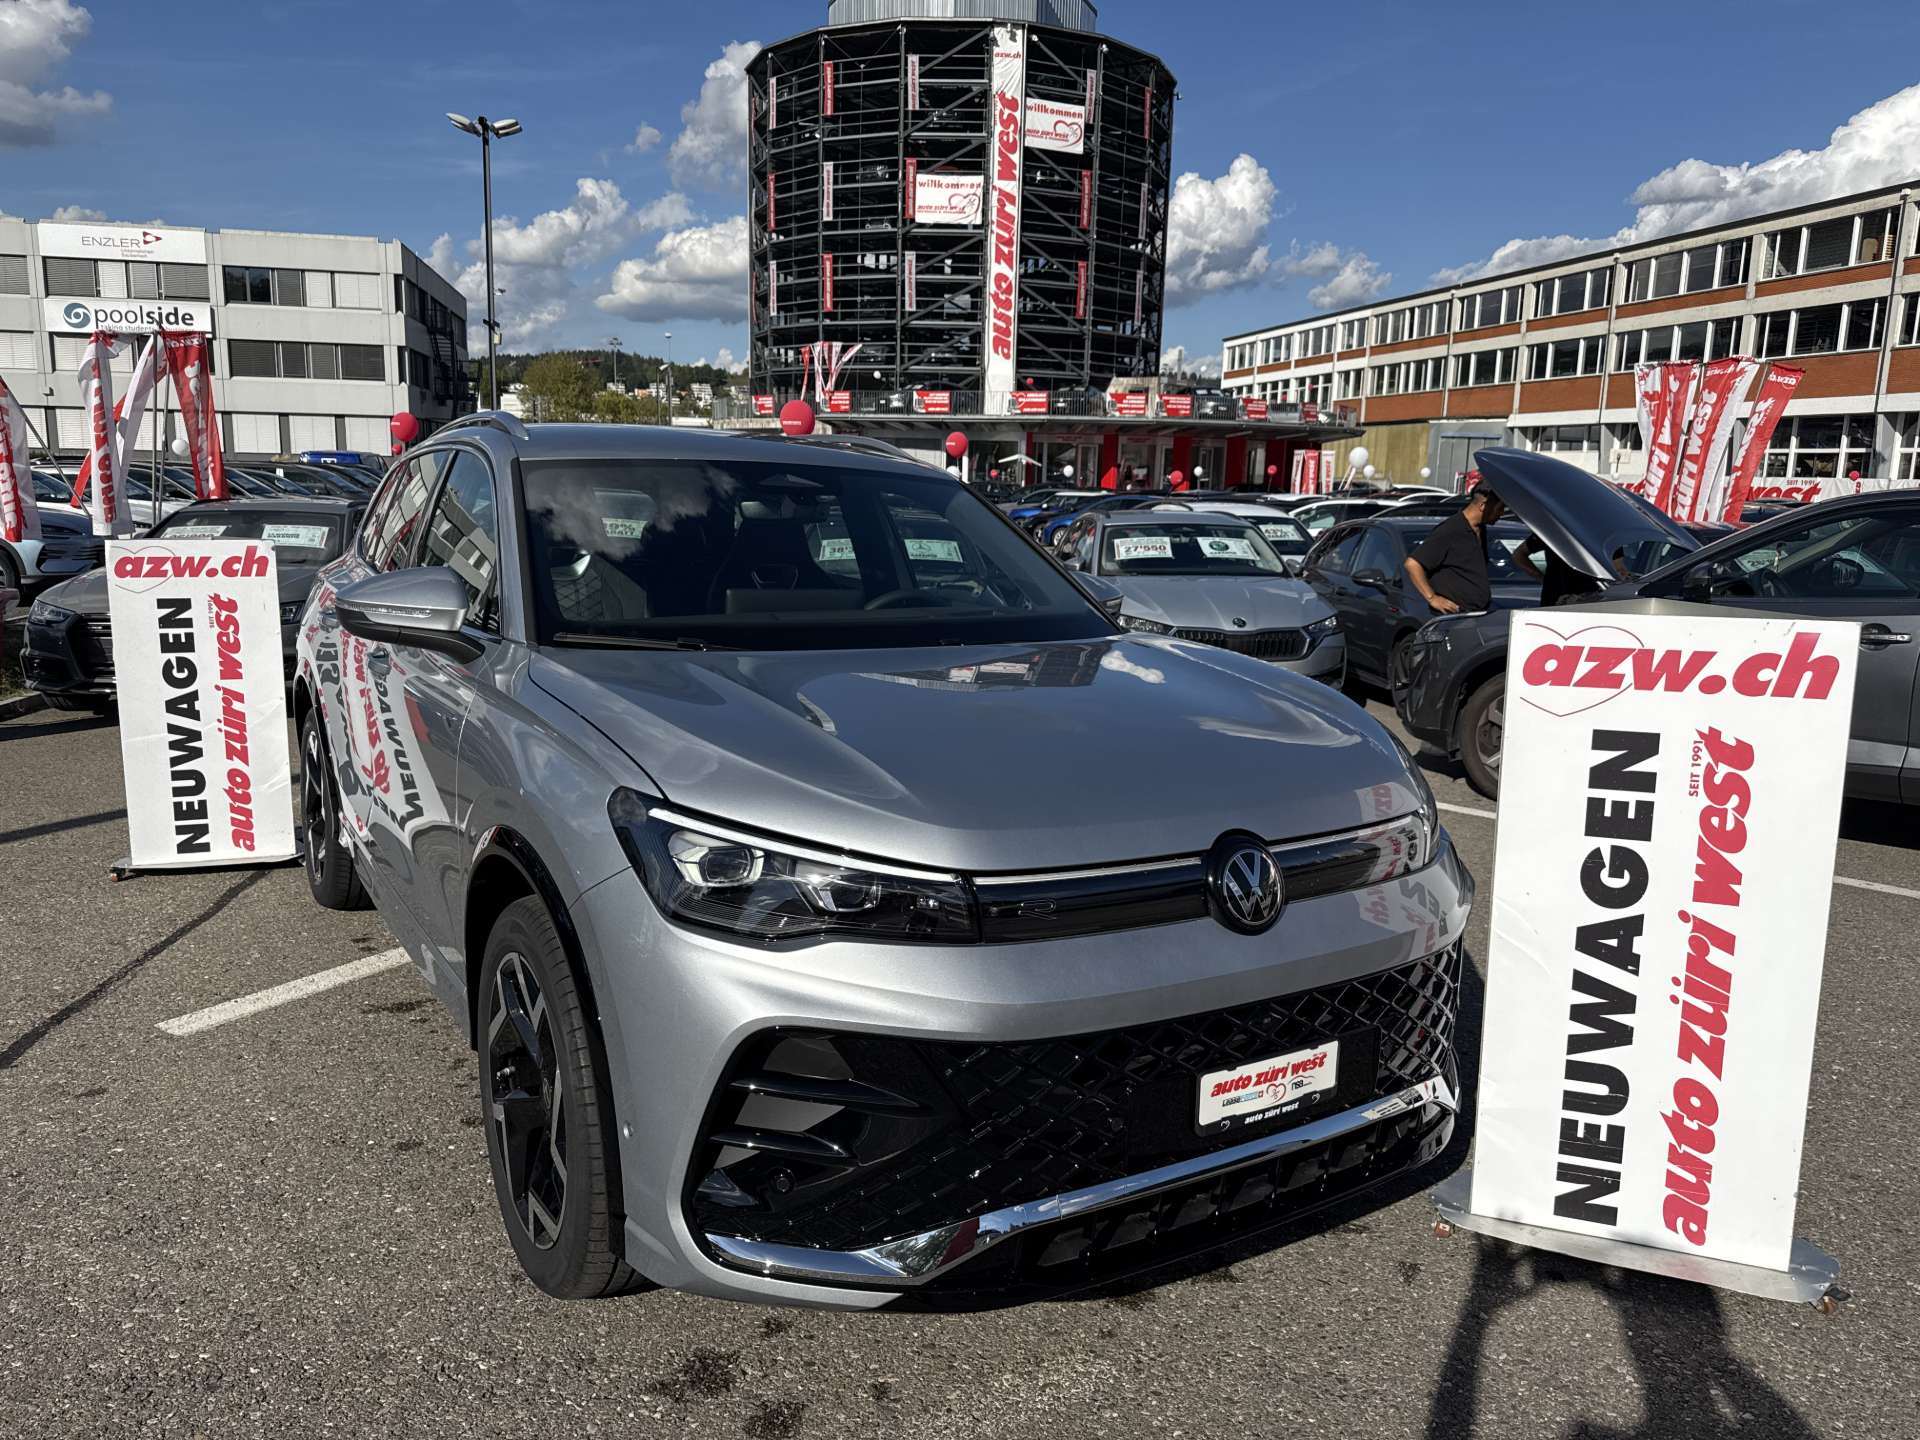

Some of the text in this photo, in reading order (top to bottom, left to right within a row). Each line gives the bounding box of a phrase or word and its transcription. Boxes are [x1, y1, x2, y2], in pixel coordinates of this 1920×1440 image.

[1025, 103, 1083, 119] willkommen
[81, 236, 141, 248] ENZLER
[990, 91, 1019, 361] auto züri west
[95, 305, 194, 329] poolside
[1688, 389, 1717, 456] west
[114, 546, 269, 578] azw.ch
[1522, 632, 1840, 700] azw.ch
[156, 597, 211, 855] NEUWAGEN
[208, 592, 255, 852] auto züri west
[1688, 738, 1704, 798] SEIT 1991
[1553, 728, 1661, 1227] NEUWAGEN
[1659, 726, 1755, 1247] auto züri west
[1211, 1052, 1328, 1097] auto züri west
[1244, 1101, 1300, 1125] auto züri west
